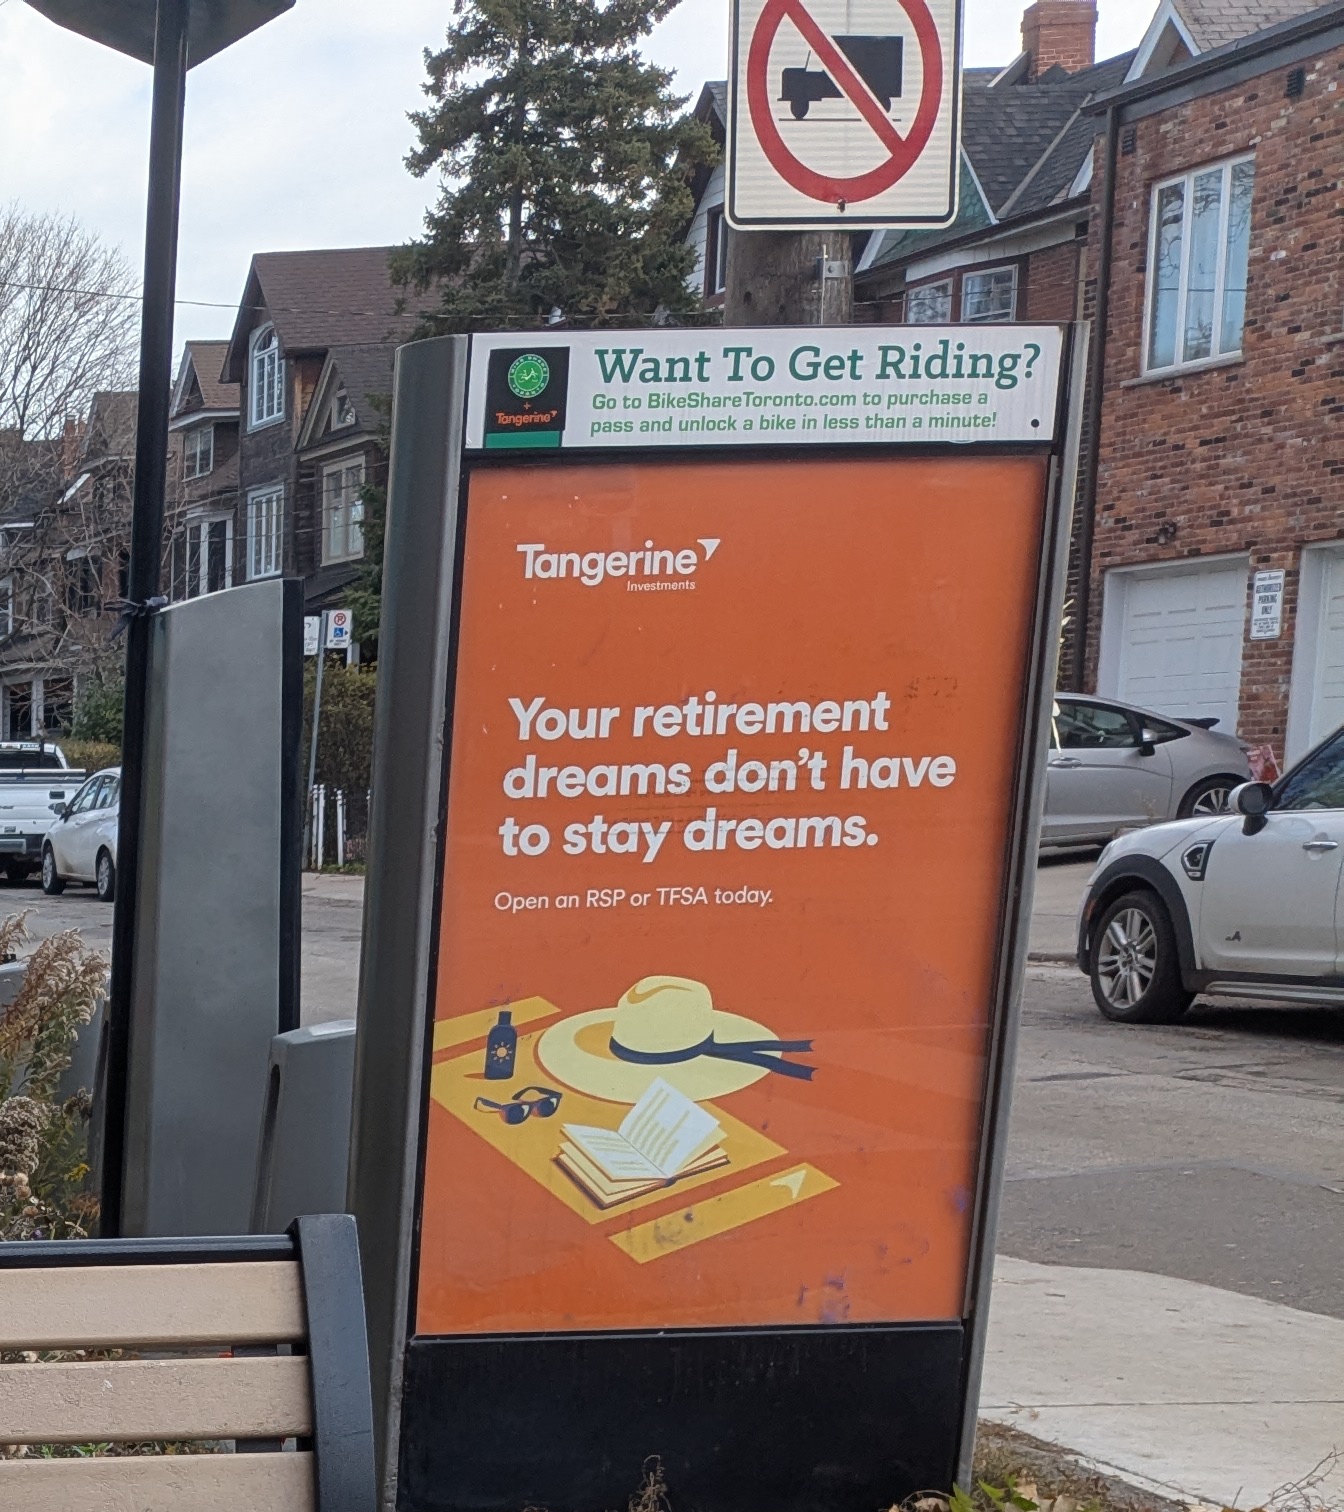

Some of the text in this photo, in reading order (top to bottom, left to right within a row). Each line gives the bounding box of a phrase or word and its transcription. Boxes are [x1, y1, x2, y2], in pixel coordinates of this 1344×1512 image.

[594, 339, 1041, 389] Want To Get Riding?
[592, 389, 988, 410] Go to BikeShareToronto.com to purchase a
[590, 411, 998, 438] pass and unlock a bike in less than a minute!
[516, 539, 698, 586] Tangerine
[627, 580, 696, 592] Investments
[508, 690, 891, 741] Your retirement
[502, 746, 958, 800] dreams don’t have
[498, 807, 879, 863] to stay dreams.
[494, 885, 774, 914] Open an RSP or TFSA today.
